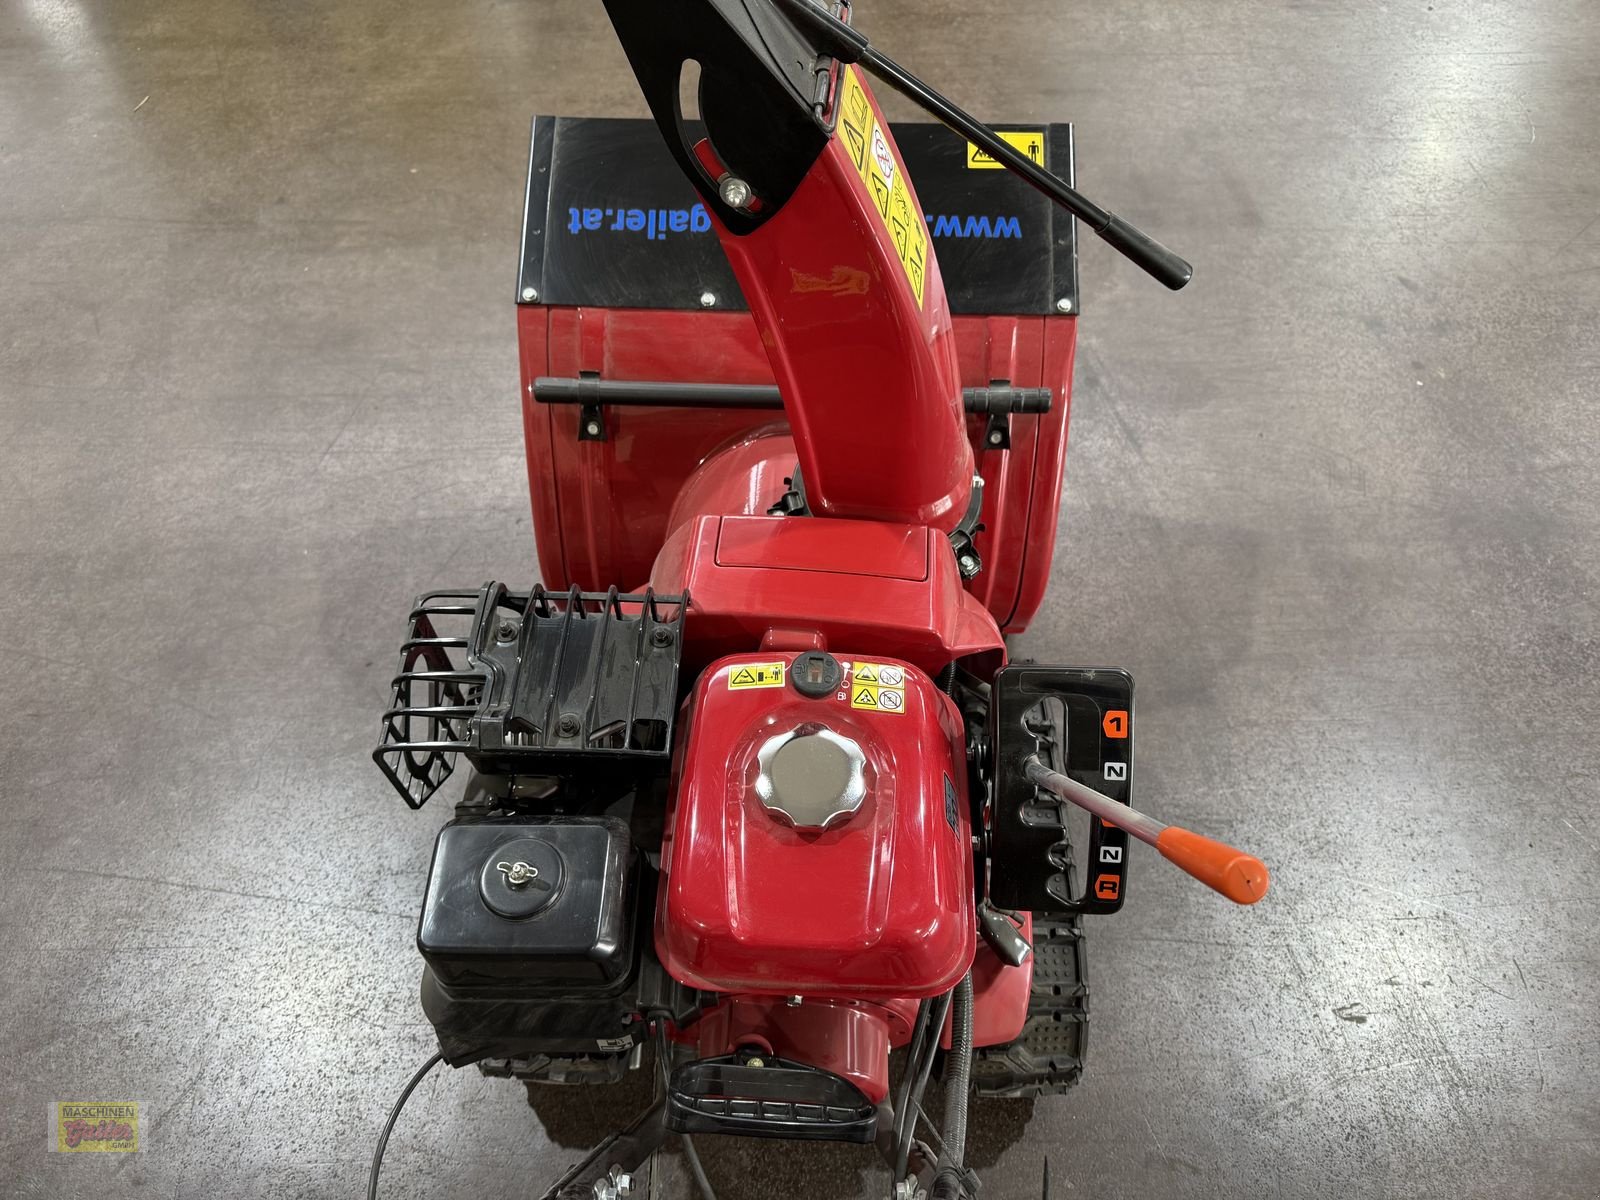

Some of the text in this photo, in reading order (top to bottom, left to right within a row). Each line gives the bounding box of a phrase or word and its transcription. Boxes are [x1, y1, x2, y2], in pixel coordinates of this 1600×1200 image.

[1109, 717, 1121, 732] 1
[1107, 766, 1123, 778] N
[1103, 849, 1119, 860] N
[1098, 881, 1118, 894] R
